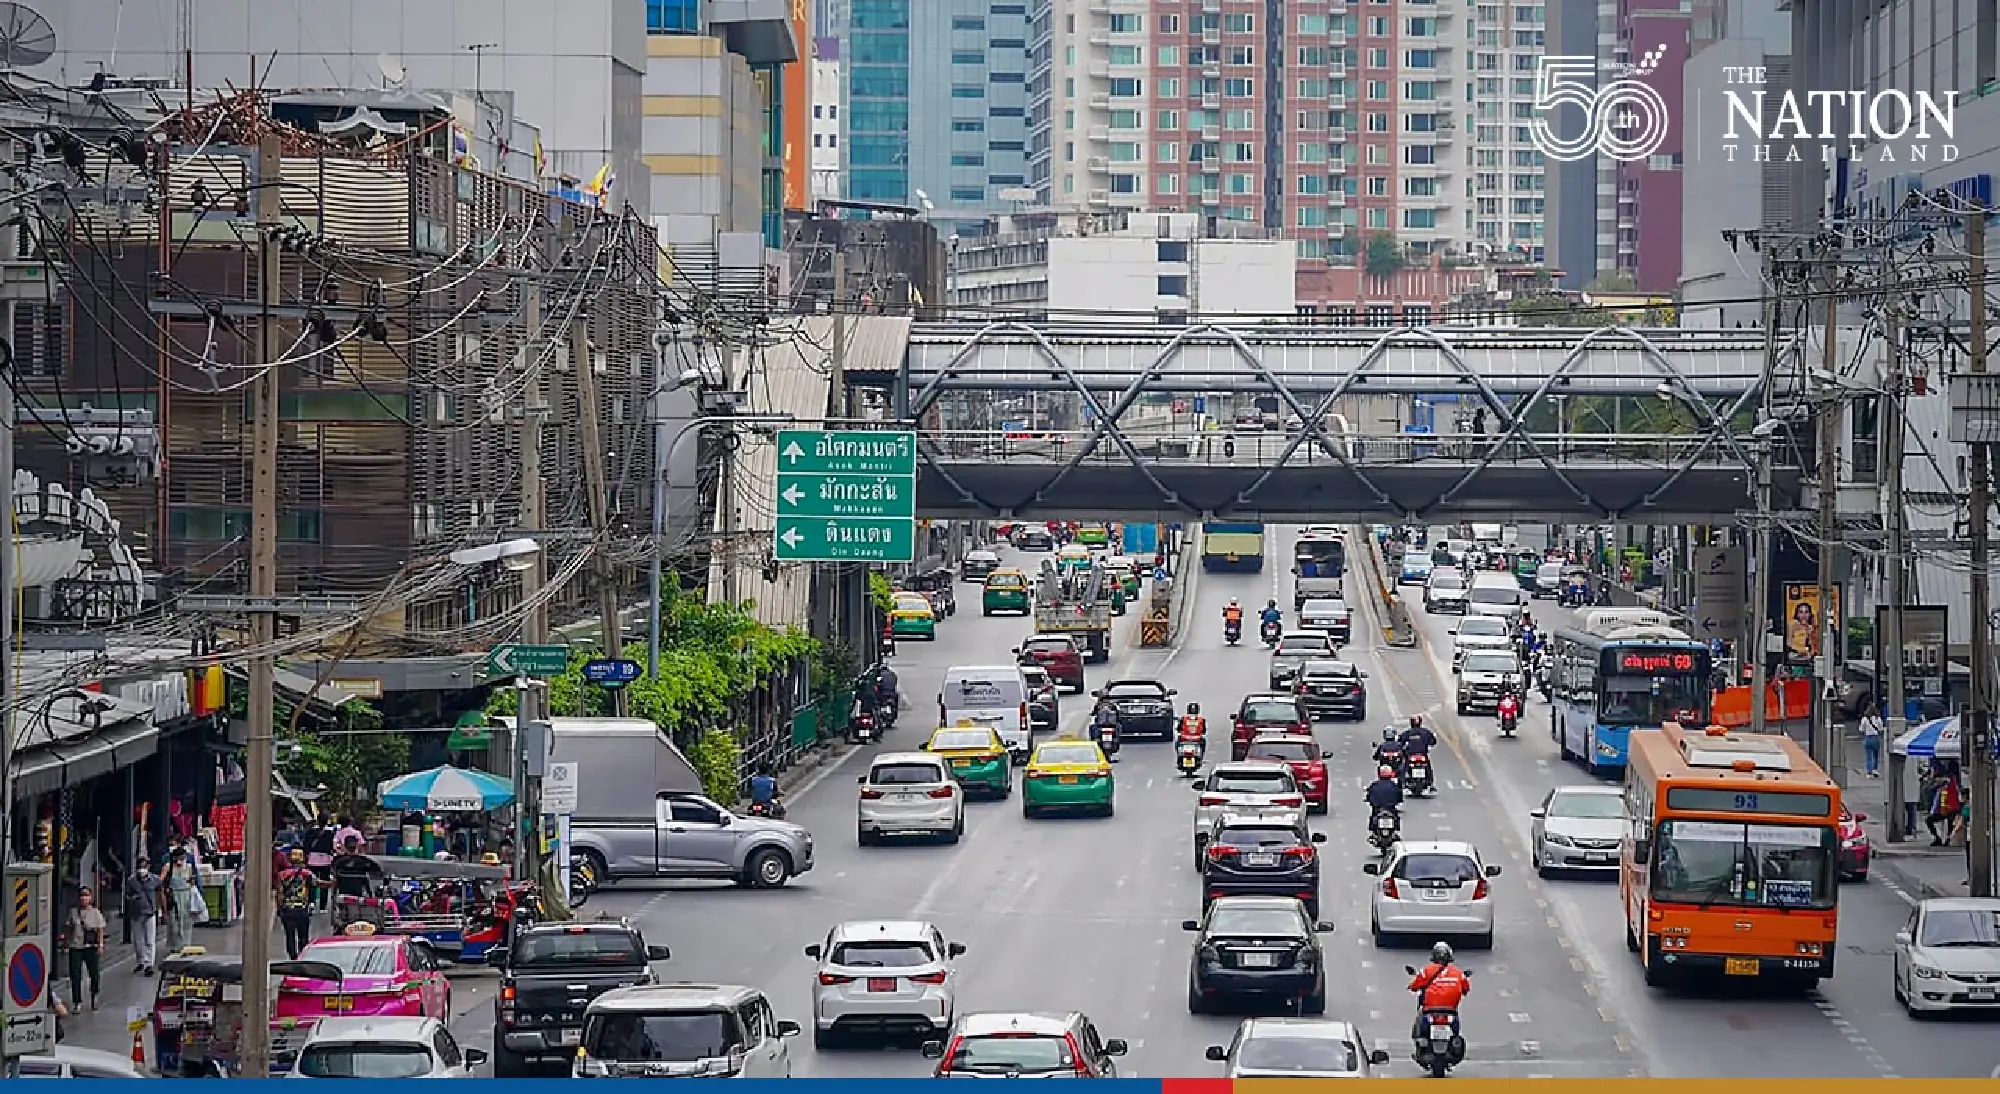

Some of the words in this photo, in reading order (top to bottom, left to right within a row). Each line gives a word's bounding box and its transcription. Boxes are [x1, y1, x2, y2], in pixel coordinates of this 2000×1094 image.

[815, 433, 910, 457] อโศกมนตรี
[819, 477, 898, 500] มักกะสัน
[826, 520, 892, 543] ดินแดง
[1674, 654, 1692, 669] 60
[1733, 794, 1758, 810] 93
[521, 1012, 573, 1022] RAN
